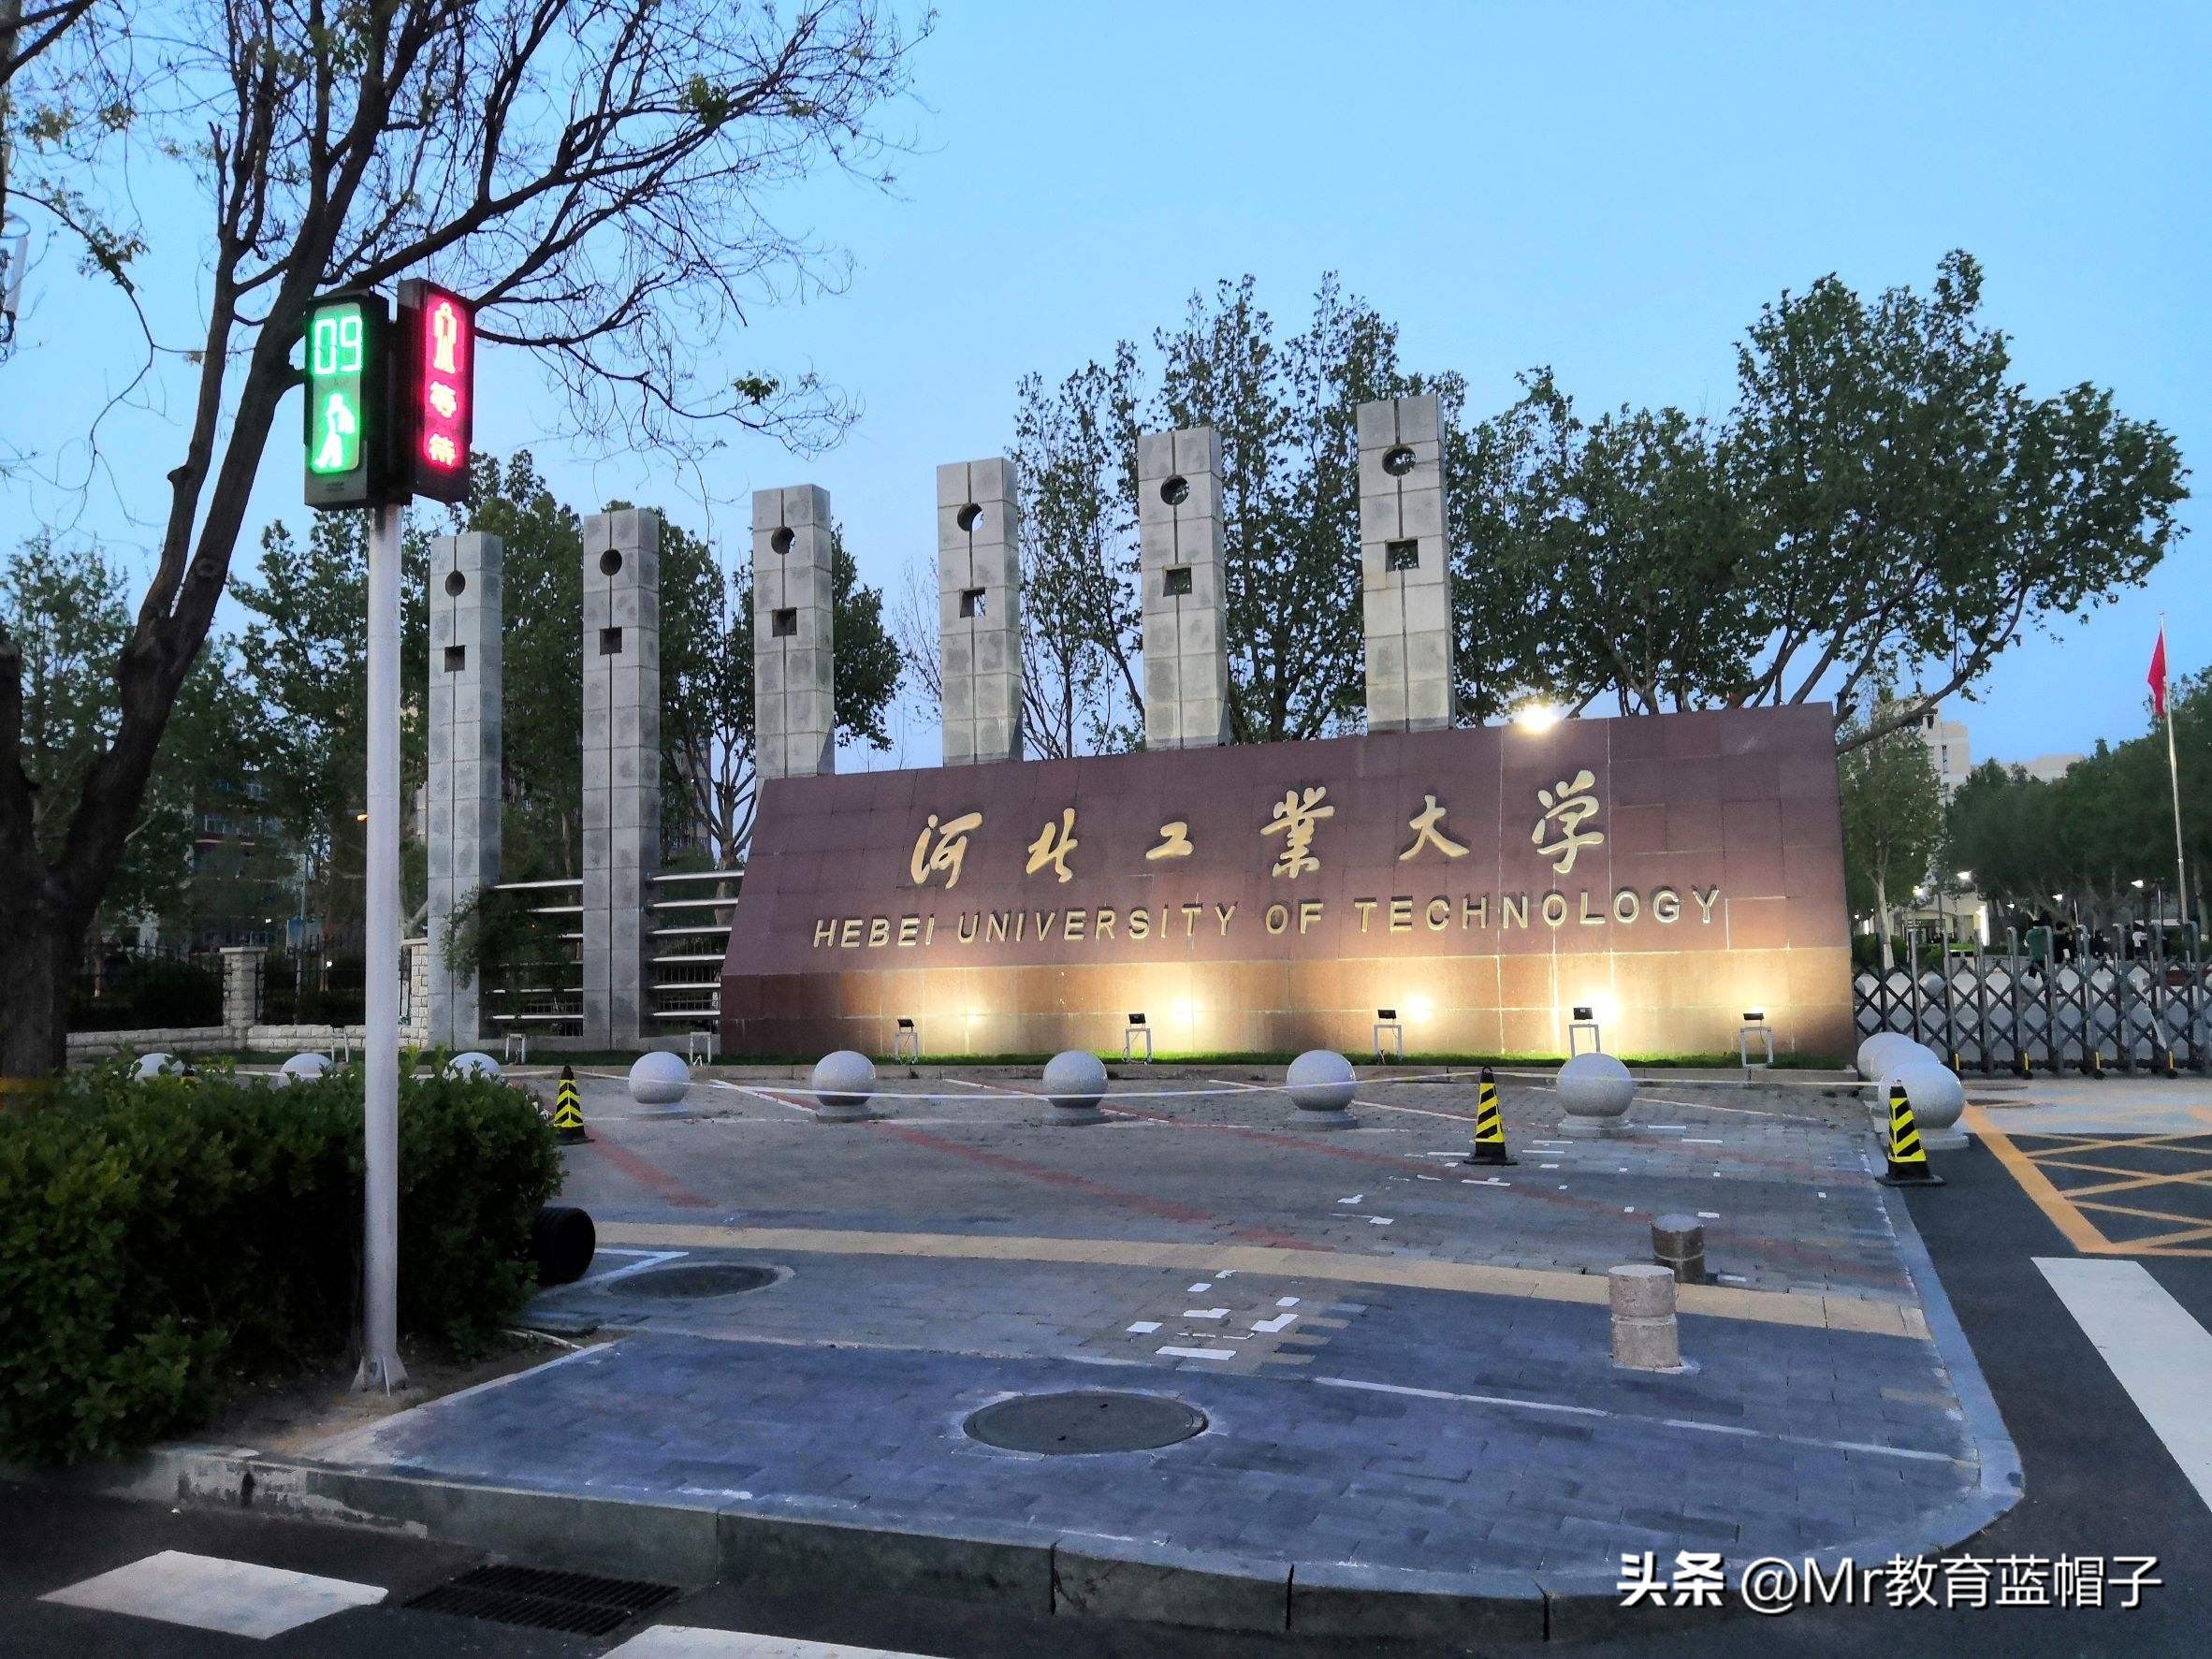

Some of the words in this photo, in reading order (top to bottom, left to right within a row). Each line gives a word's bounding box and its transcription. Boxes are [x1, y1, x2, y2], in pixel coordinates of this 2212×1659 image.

[313, 314, 363, 375] 09
[813, 914, 935, 948] HEBEI
[957, 901, 1238, 943] UNIVERSITY
[1265, 897, 1324, 935] OF
[1354, 884, 1721, 934] TECHNOLOGY
